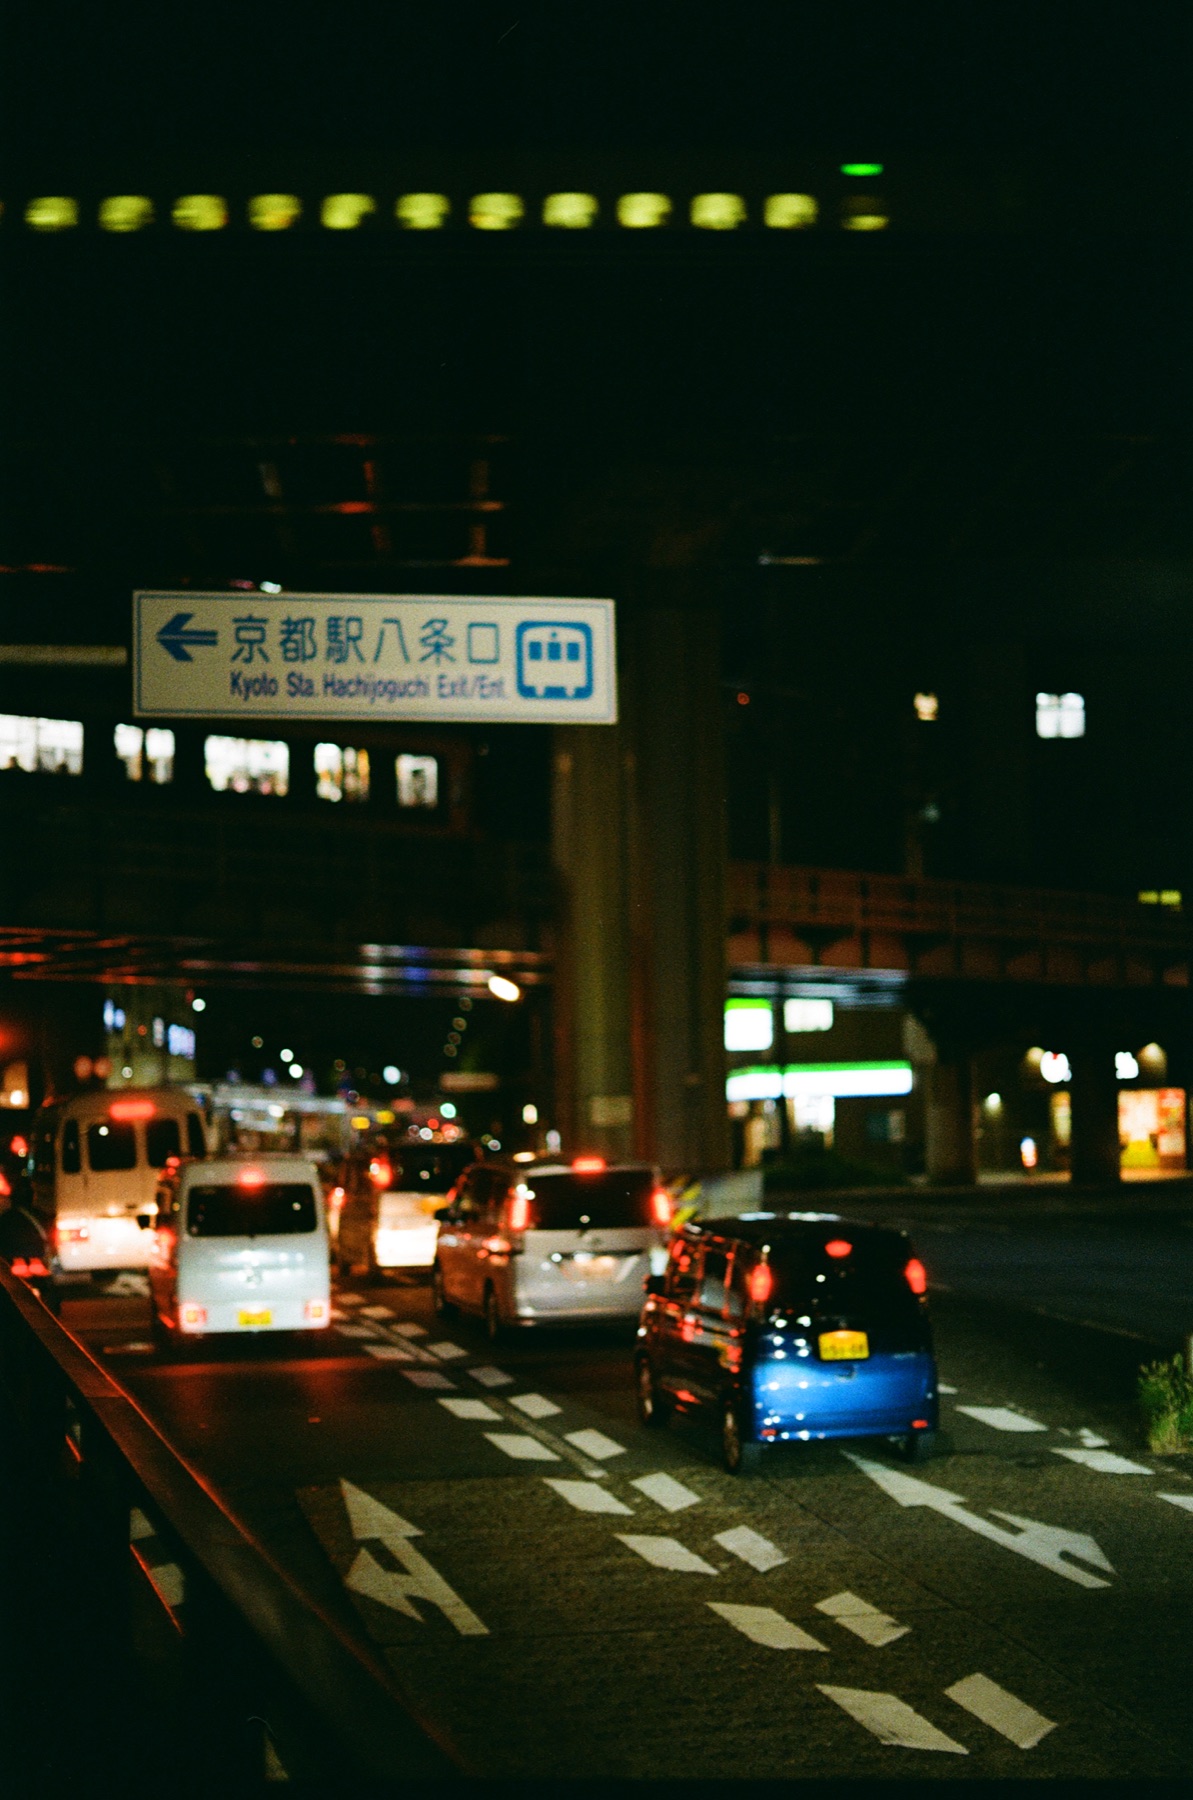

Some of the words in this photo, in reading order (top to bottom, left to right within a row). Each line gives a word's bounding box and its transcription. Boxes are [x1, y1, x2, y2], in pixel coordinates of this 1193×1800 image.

[230, 615, 500, 665] 京都駅八条口
[230, 671, 279, 701] Kyoto
[322, 673, 430, 704] Hachijoguchi
